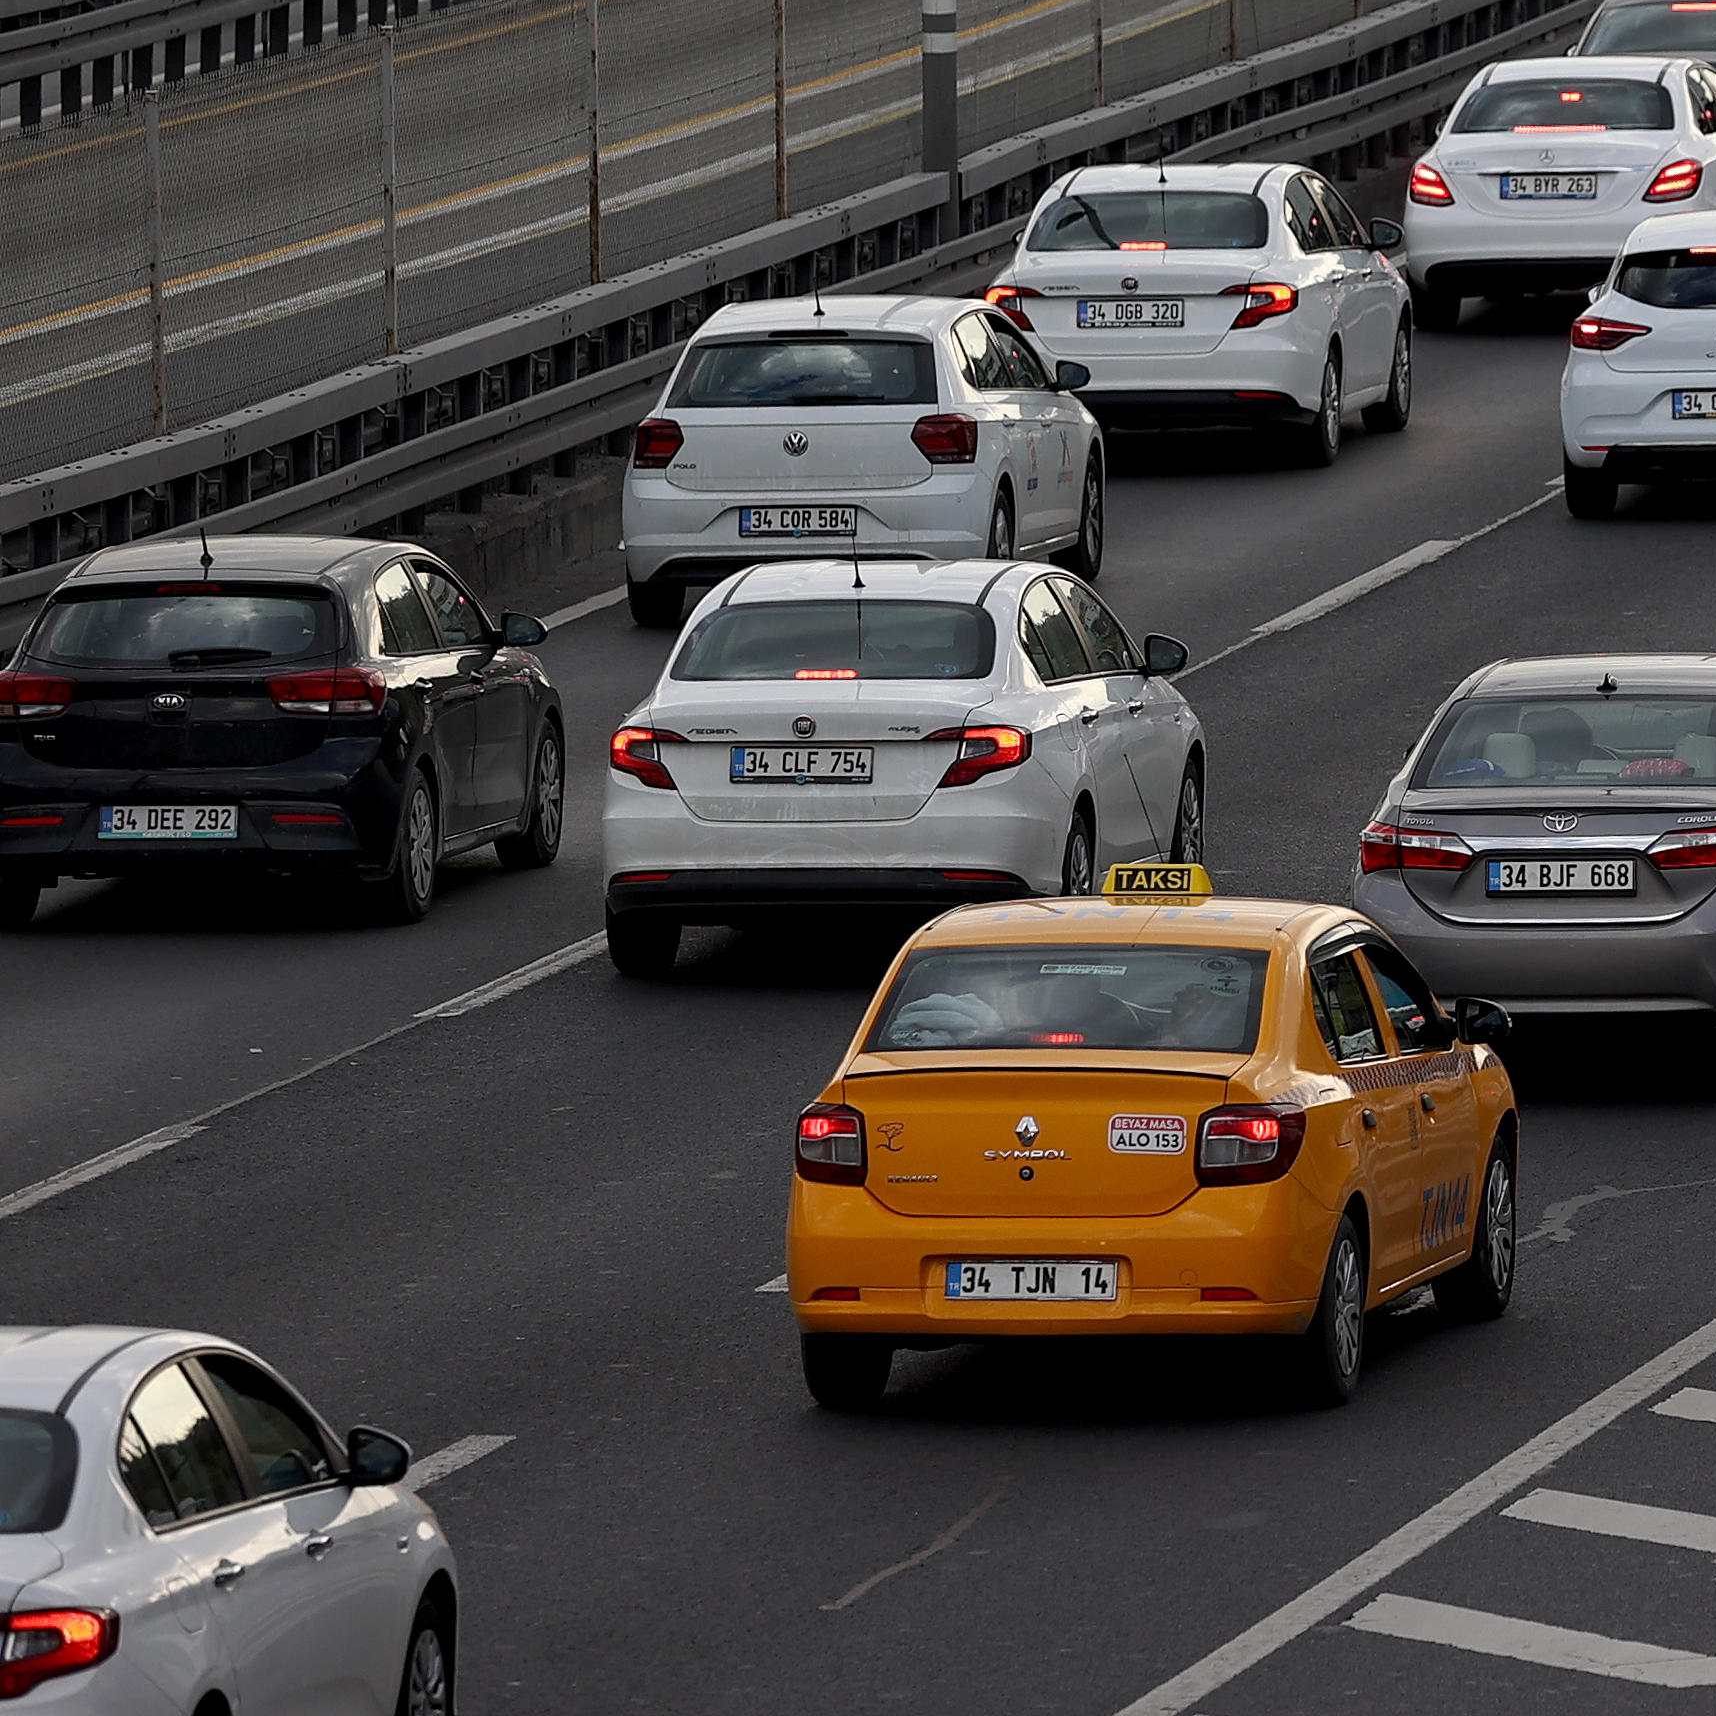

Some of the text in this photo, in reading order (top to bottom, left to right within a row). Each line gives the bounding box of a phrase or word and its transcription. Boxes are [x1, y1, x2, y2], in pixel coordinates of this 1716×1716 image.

[1510, 177, 1593, 194] 34 BYR 263
[1089, 303, 1179, 321] 34 DGB 320
[1683, 394, 1703, 412] 34
[752, 509, 850, 529] 34 COR 584
[745, 751, 770, 774] 34
[781, 751, 820, 774] CLF
[830, 751, 868, 774] 754
[113, 808, 138, 831] 34
[147, 808, 185, 831] DEE
[195, 808, 233, 831] 292
[1406, 816, 1435, 826] TOYOTA
[1501, 864, 1526, 888] 34
[1538, 864, 1577, 888] BJF
[1589, 864, 1629, 888] 668
[1113, 1117, 1182, 1131] BEYAZ MASA
[1114, 1132, 1180, 1149] ALO 153
[983, 1148, 1073, 1162] SYMBOL
[949, 1266, 1109, 1294] TR 34 TJN 14
